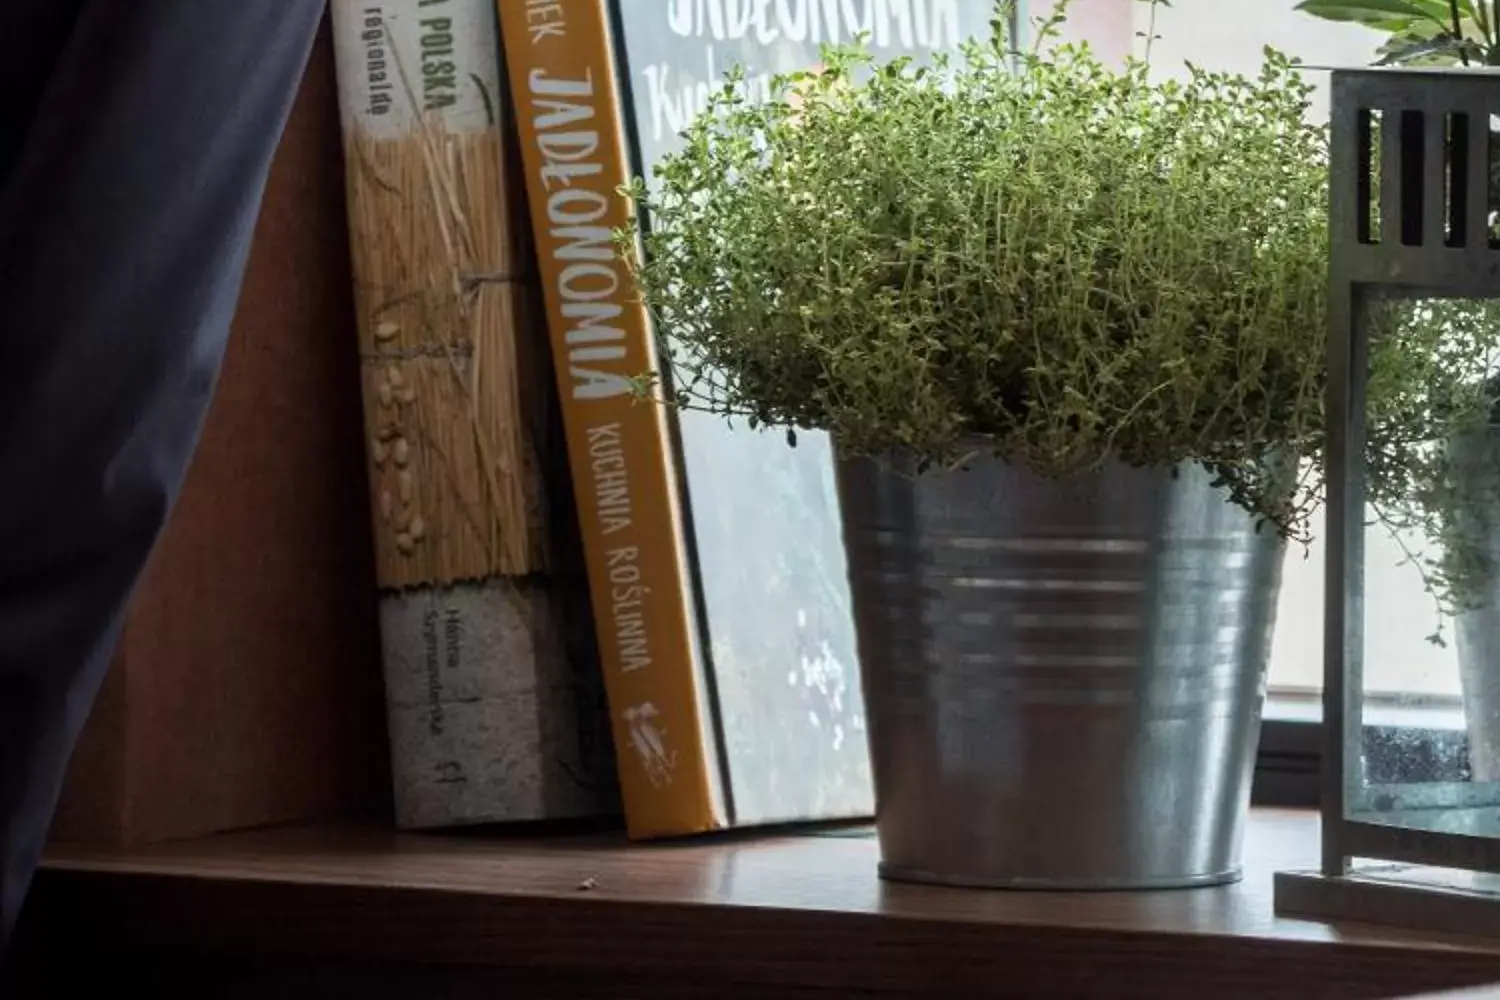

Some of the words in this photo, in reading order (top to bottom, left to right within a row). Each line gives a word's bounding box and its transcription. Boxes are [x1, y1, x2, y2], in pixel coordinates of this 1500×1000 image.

[419, 16, 457, 110] POLSKA
[529, 66, 634, 400] JADŁONOMIA
[586, 422, 633, 536] KUCHNIA
[606, 545, 653, 673] ROŚLINNA
